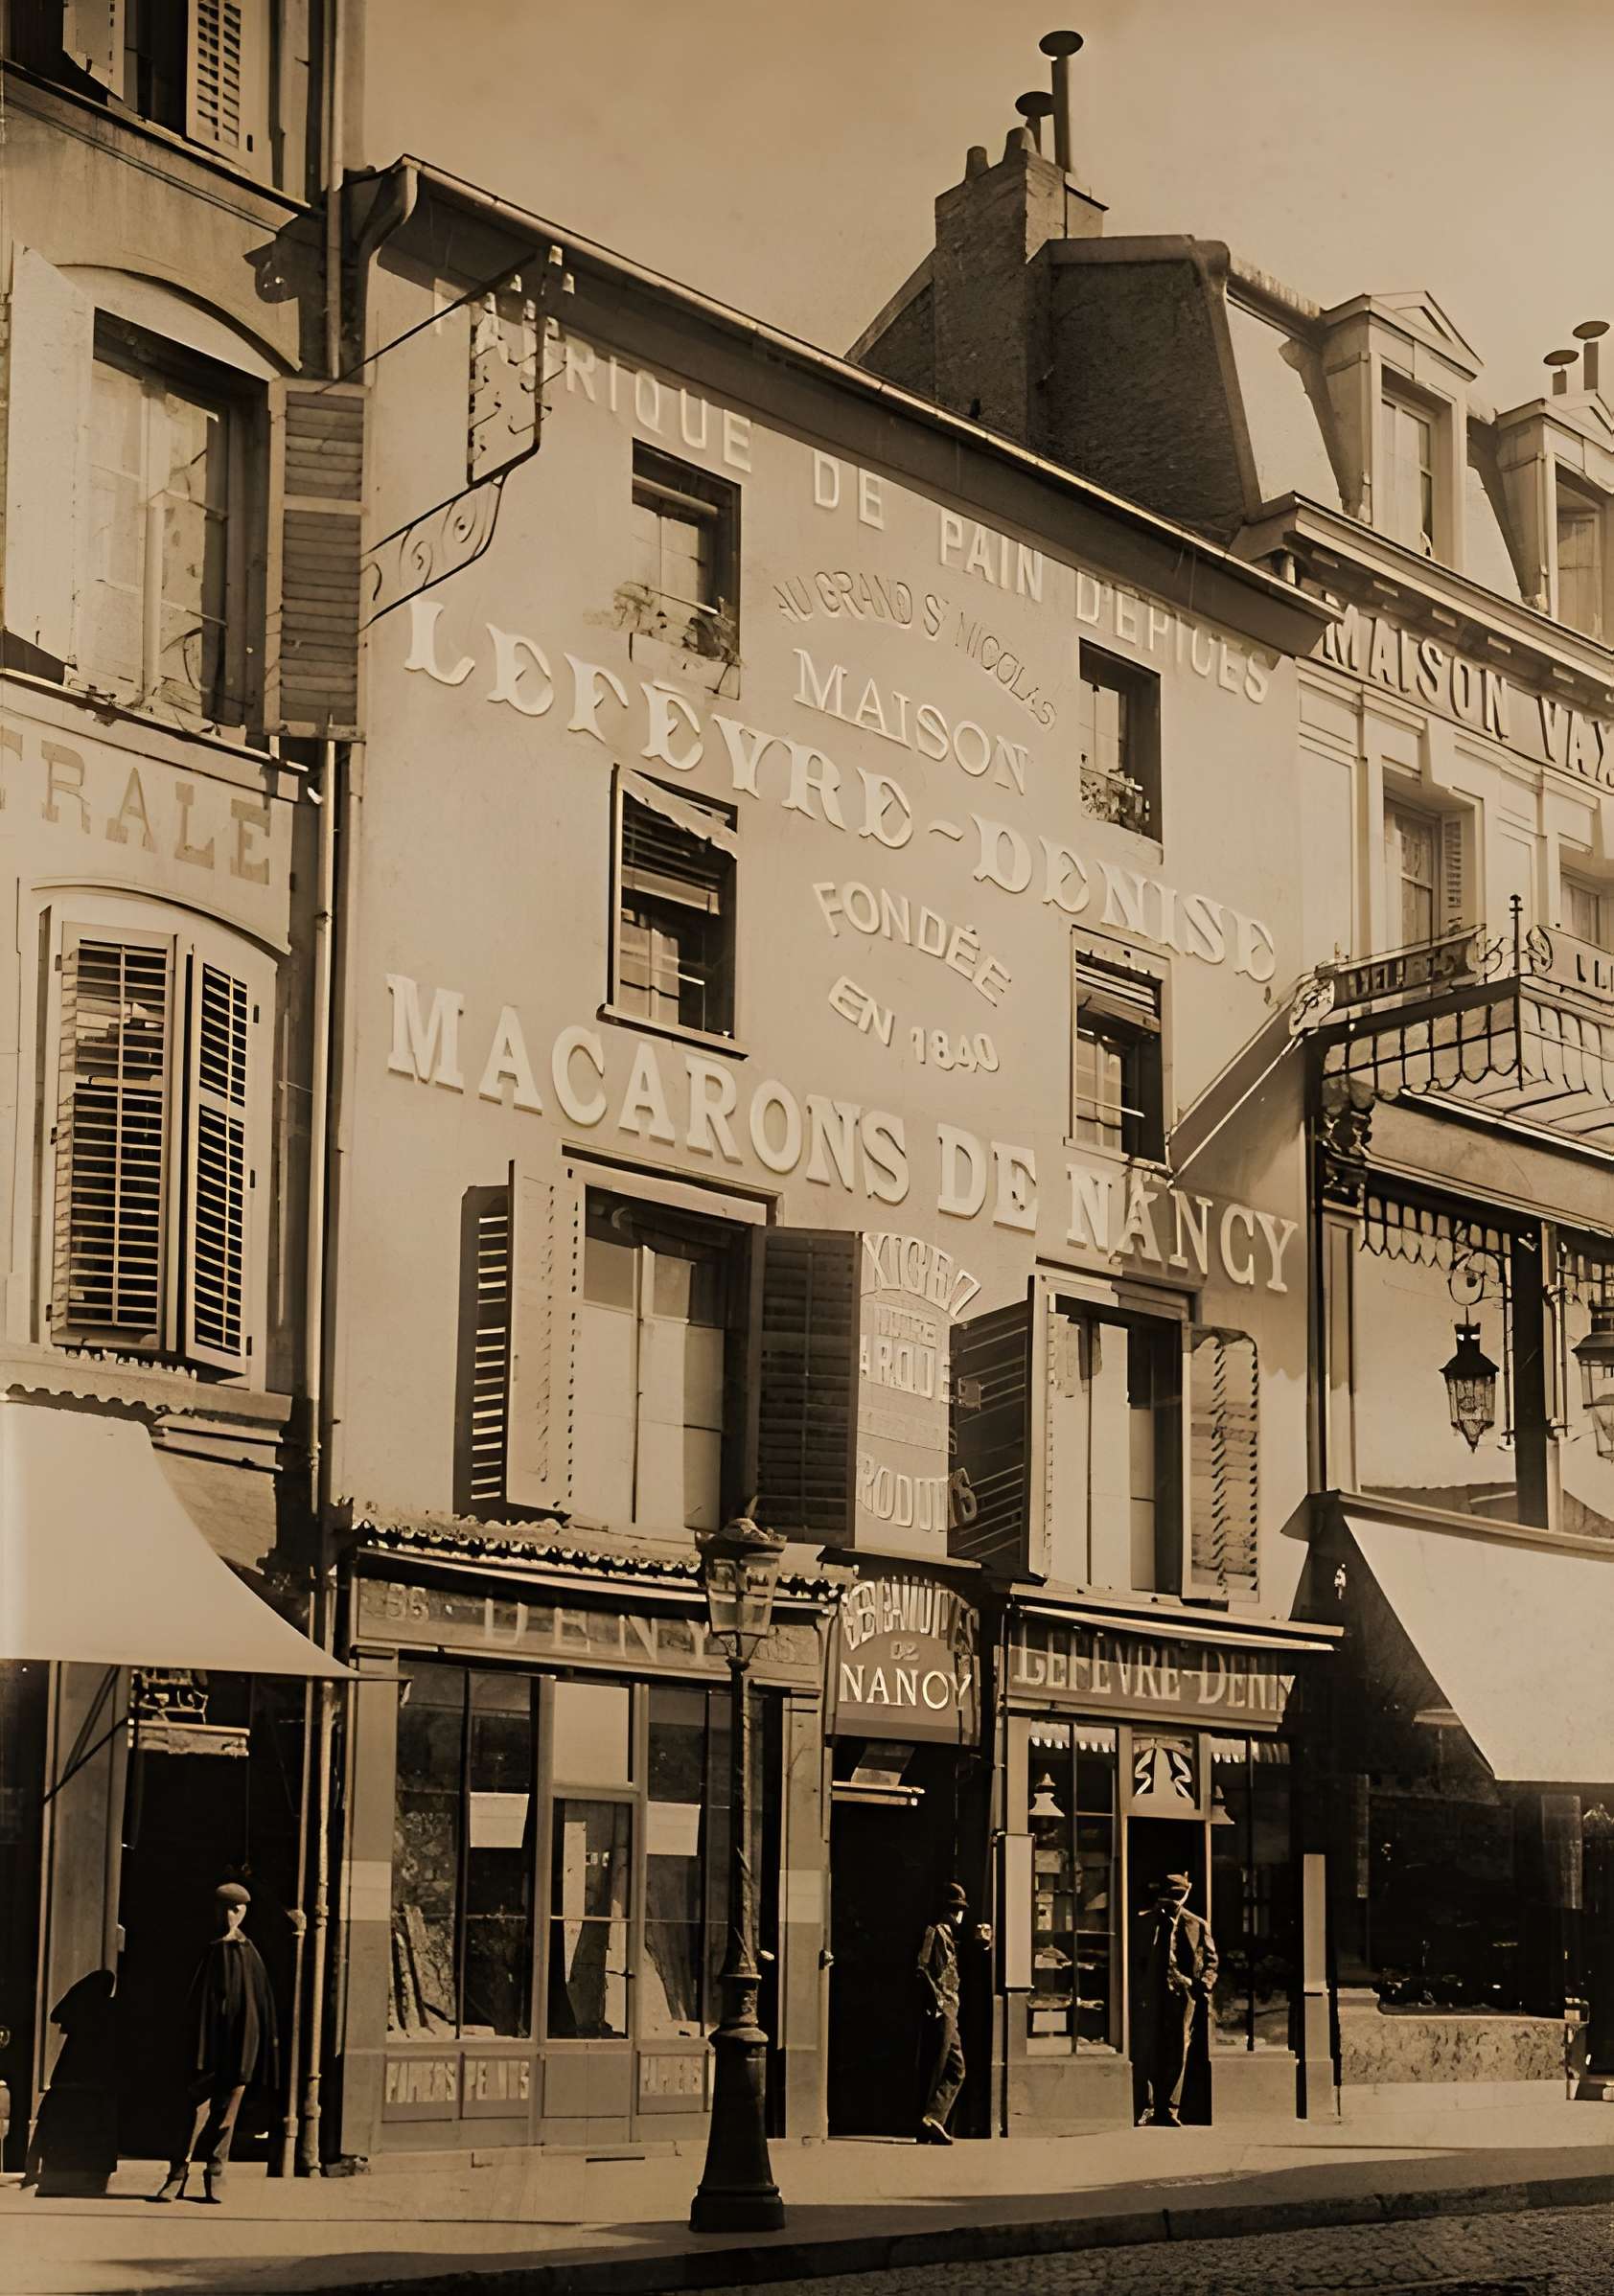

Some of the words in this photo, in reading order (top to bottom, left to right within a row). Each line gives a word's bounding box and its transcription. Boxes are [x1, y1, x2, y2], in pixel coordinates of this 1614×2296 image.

[813, 449, 885, 531] DE
[940, 508, 1044, 604] PAIN
[793, 648, 1029, 795] MAISON
[954, 609, 1058, 734] NICOLAS
[1322, 590, 1510, 740] MAISON
[1536, 694, 1614, 788] VAY
[827, 976, 896, 1047] EN
[386, 972, 910, 1205] MACARONS
[936, 1122, 1038, 1233] DE
[1065, 1163, 1299, 1294] NANCY
